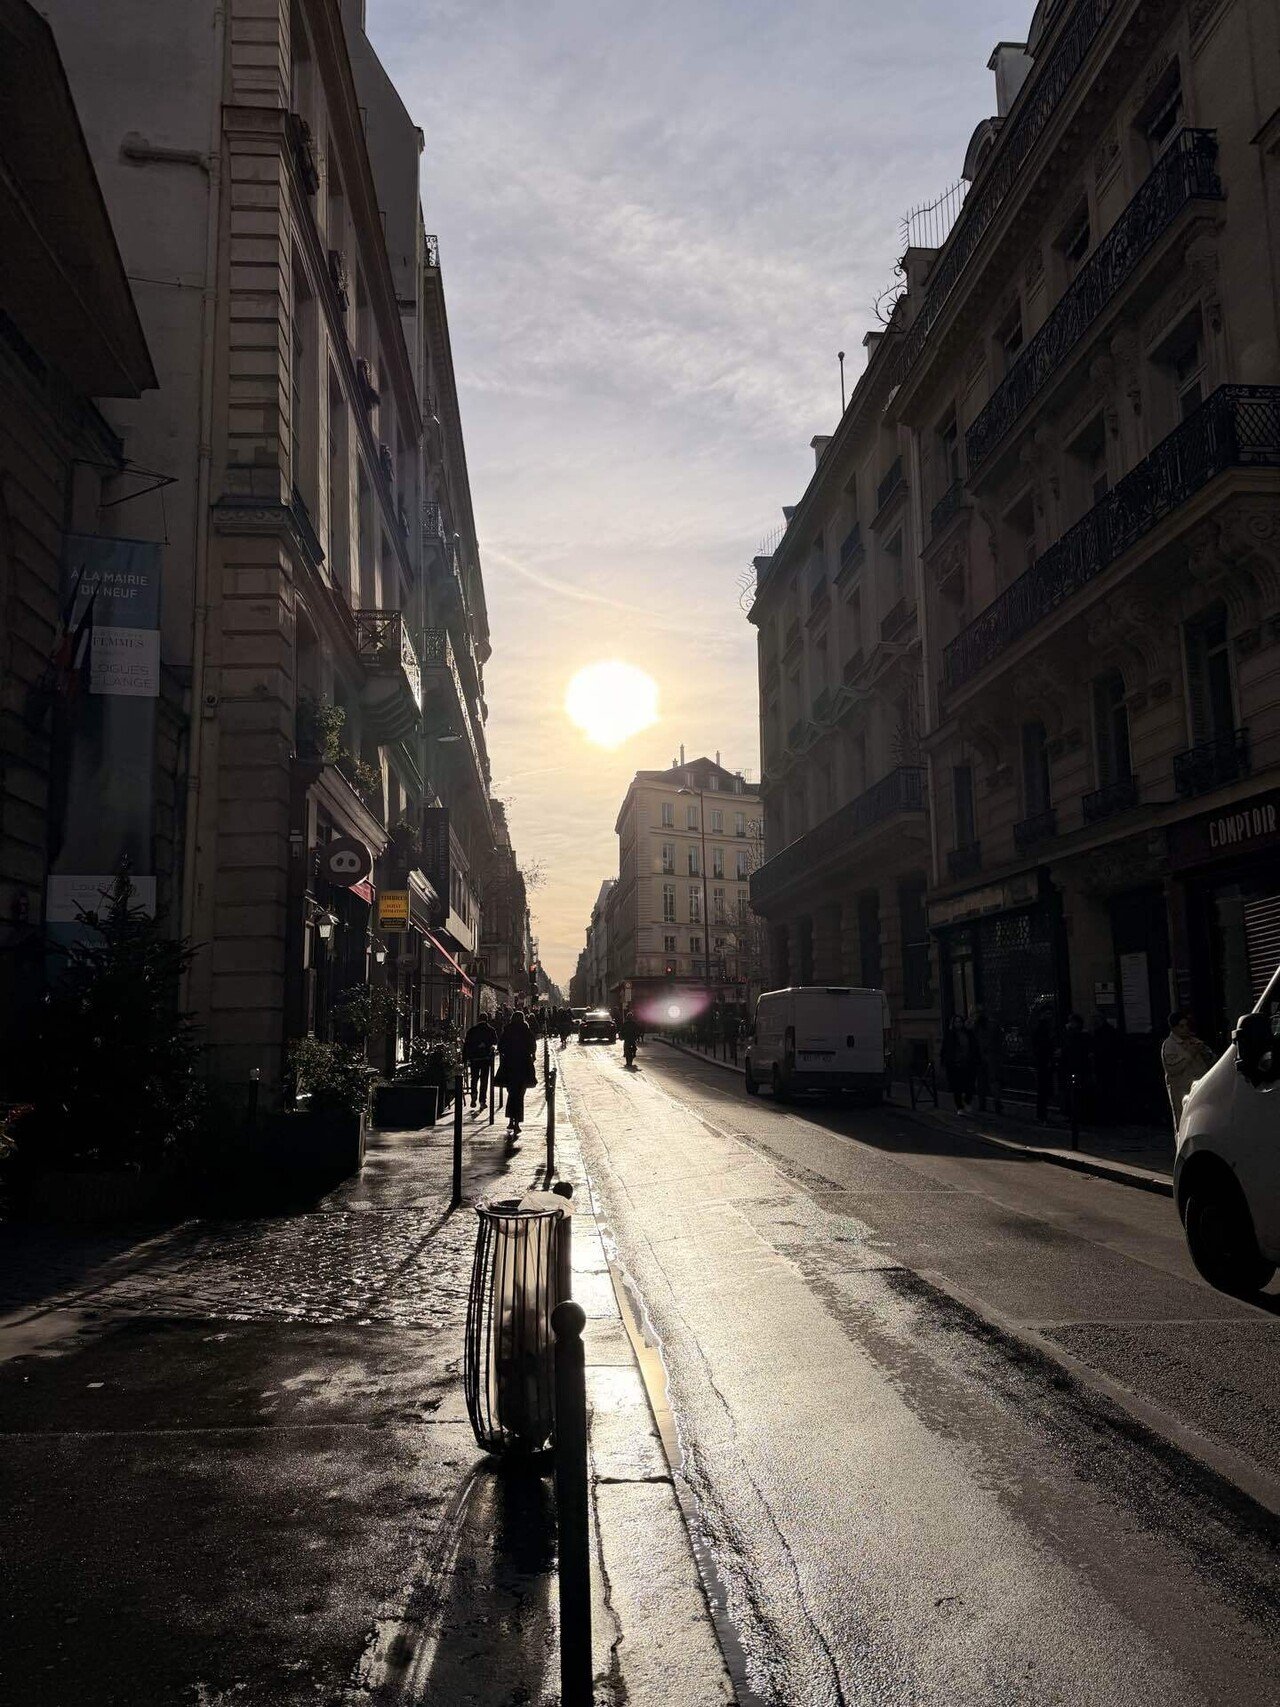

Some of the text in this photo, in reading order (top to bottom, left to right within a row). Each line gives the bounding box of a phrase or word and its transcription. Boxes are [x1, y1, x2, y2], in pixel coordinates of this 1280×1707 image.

[84, 571, 100, 581] LA
[104, 573, 149, 586] MAIRIE
[81, 584, 138, 598] DU NEUF
[1209, 804, 1277, 848] COMPTOIR
